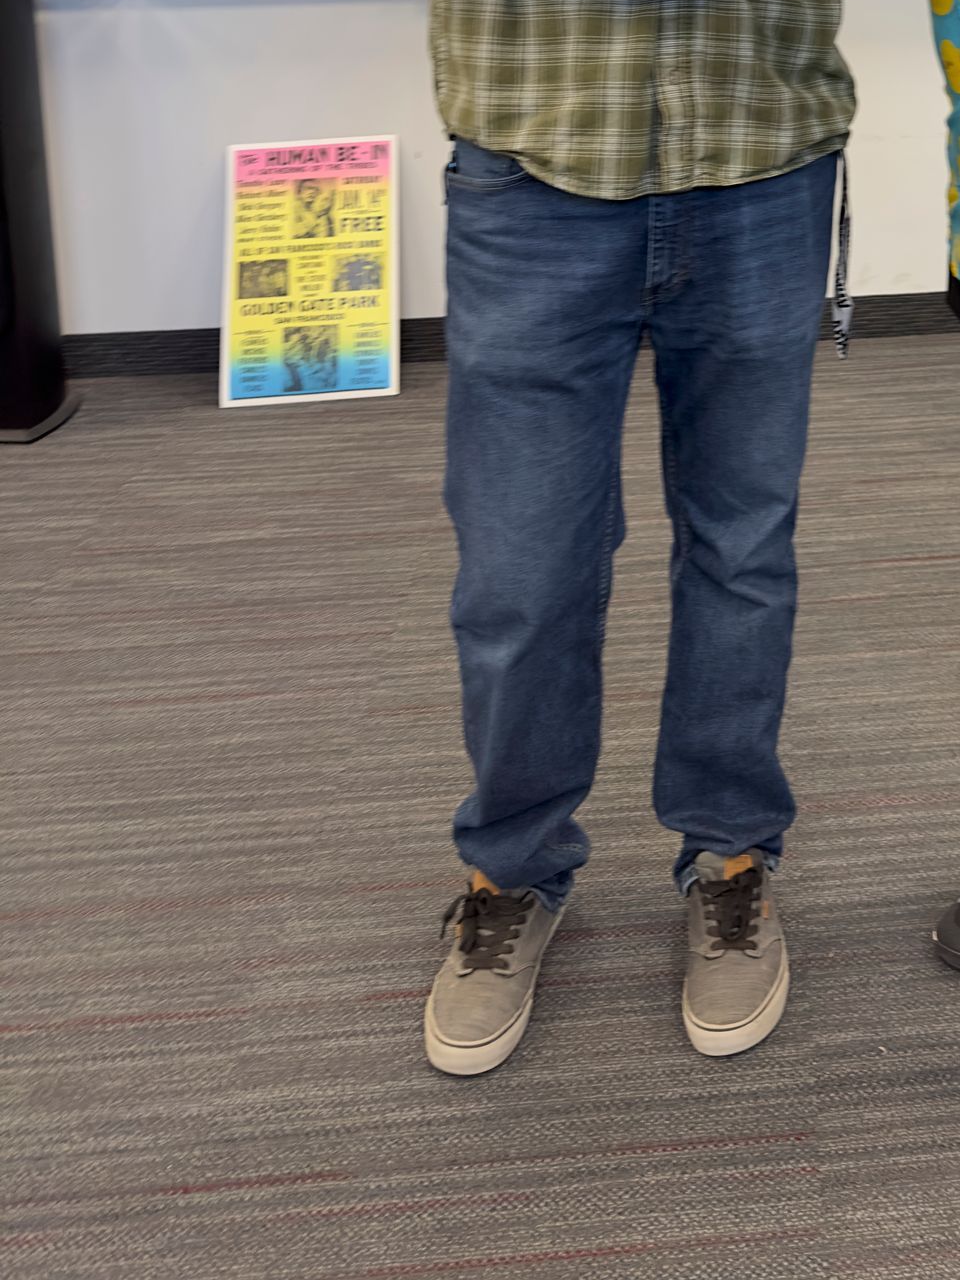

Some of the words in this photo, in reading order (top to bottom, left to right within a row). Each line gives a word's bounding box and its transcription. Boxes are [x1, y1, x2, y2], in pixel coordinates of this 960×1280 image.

[266, 147, 329, 166] HUMAN
[339, 216, 385, 234] FREE
[241, 300, 294, 317] GOLDEN
[299, 297, 335, 313] GATE
[339, 295, 379, 309] PARK
